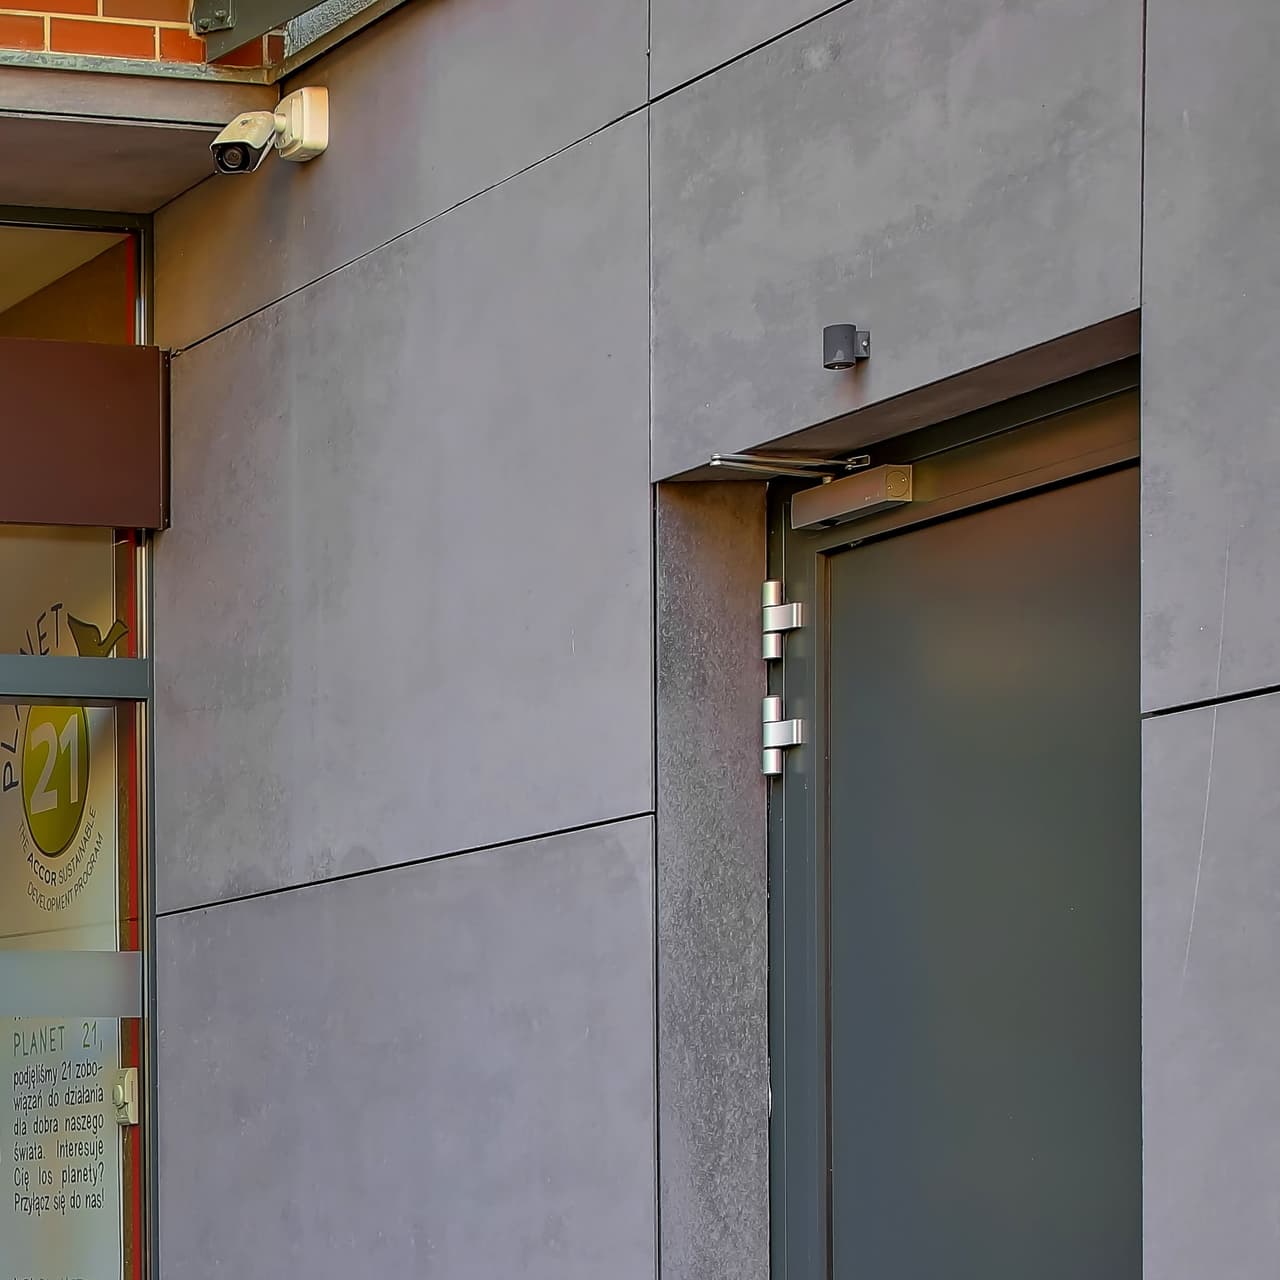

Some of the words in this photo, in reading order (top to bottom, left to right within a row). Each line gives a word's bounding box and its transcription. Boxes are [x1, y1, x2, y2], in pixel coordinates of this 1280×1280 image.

[30, 713, 79, 815] 21
[27, 852, 58, 887] ACCOR
[58, 806, 97, 885] SUSTAINABLE
[27, 881, 73, 912] DEVELOPMENT
[73, 832, 104, 897] PROGRAM
[13, 1025, 65, 1057] PLANET
[13, 1063, 58, 1092] podjęliśmy
[61, 1060, 72, 1081] 21
[75, 1058, 103, 1079] zobo-
[13, 1089, 43, 1117] wiązań
[48, 1088, 60, 1107] do
[64, 1083, 104, 1106] działania
[13, 1116, 27, 1137] dla
[33, 1115, 59, 1135] dobra
[64, 1113, 104, 1135] naszego
[13, 1141, 46, 1162] świata.
[56, 1136, 104, 1161] Interesuje
[13, 1167, 30, 1192] Cię
[38, 1166, 53, 1185] los
[61, 1161, 104, 1188] planety?
[14, 1192, 50, 1217] Przyłącz
[53, 1190, 66, 1216] się
[70, 1189, 81, 1209] do
[85, 1187, 105, 1209] nas!
